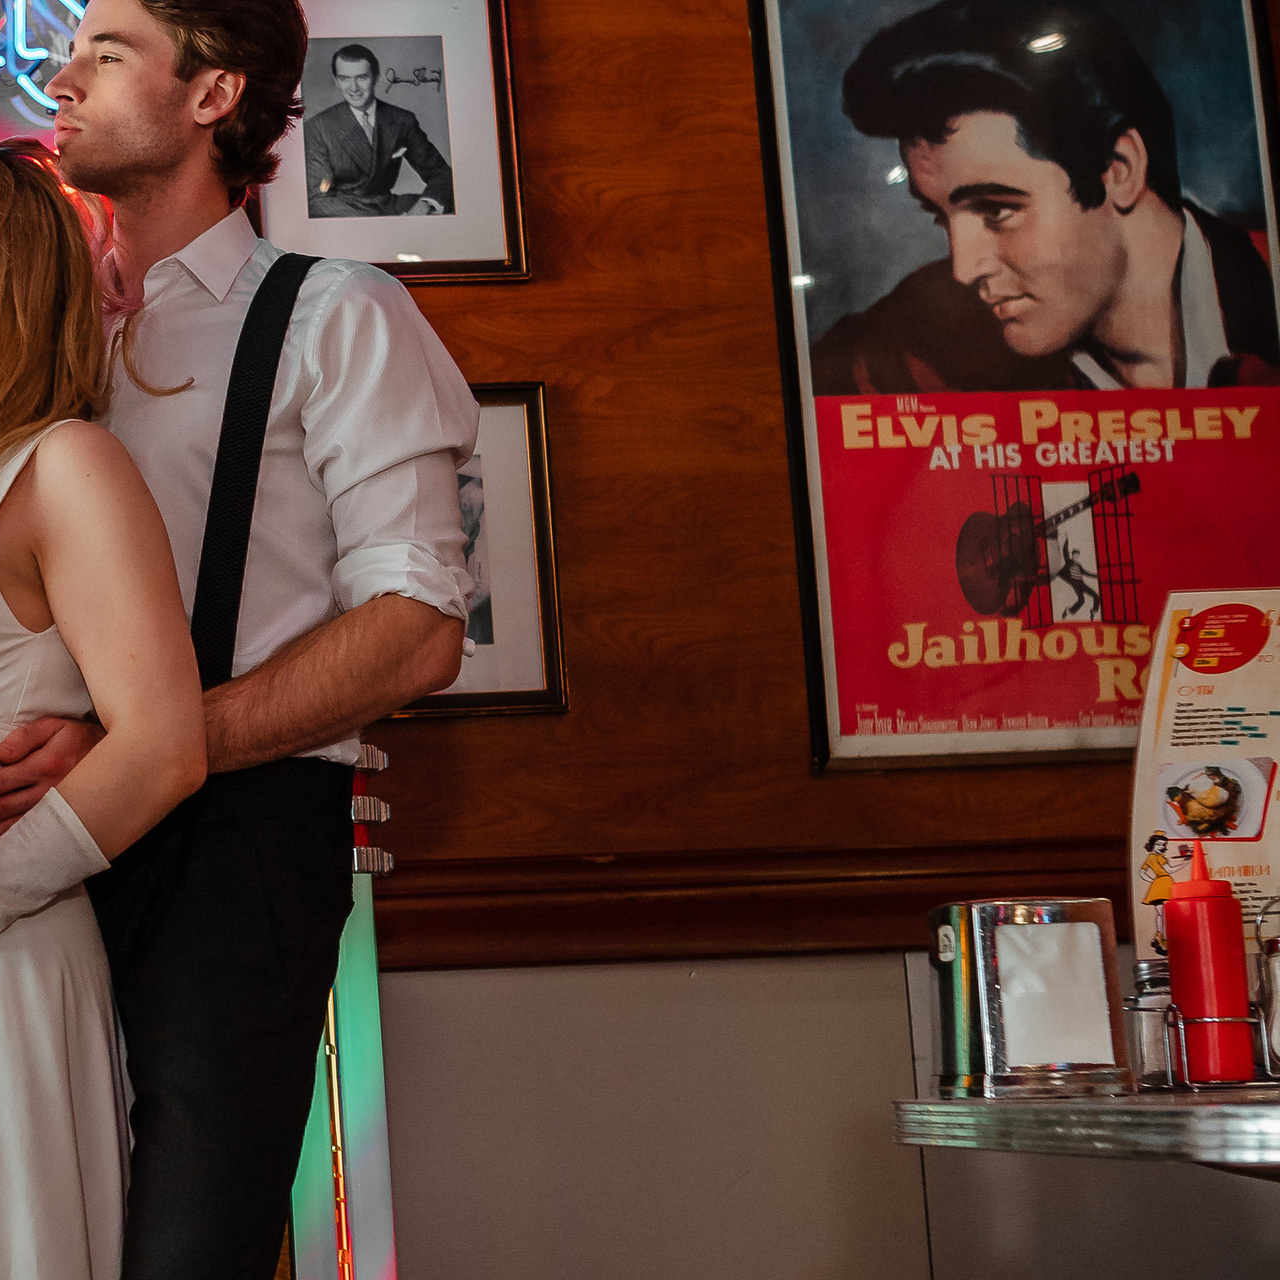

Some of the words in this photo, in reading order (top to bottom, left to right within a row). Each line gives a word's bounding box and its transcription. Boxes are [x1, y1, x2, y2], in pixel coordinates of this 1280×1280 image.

[840, 403, 998, 449] ELVIS
[1018, 399, 1260, 446] PRESLEY
[928, 442, 962, 470] AT
[973, 441, 1022, 468] HIS
[1034, 438, 1176, 468] GREATEST
[887, 616, 1156, 669] Jailhous
